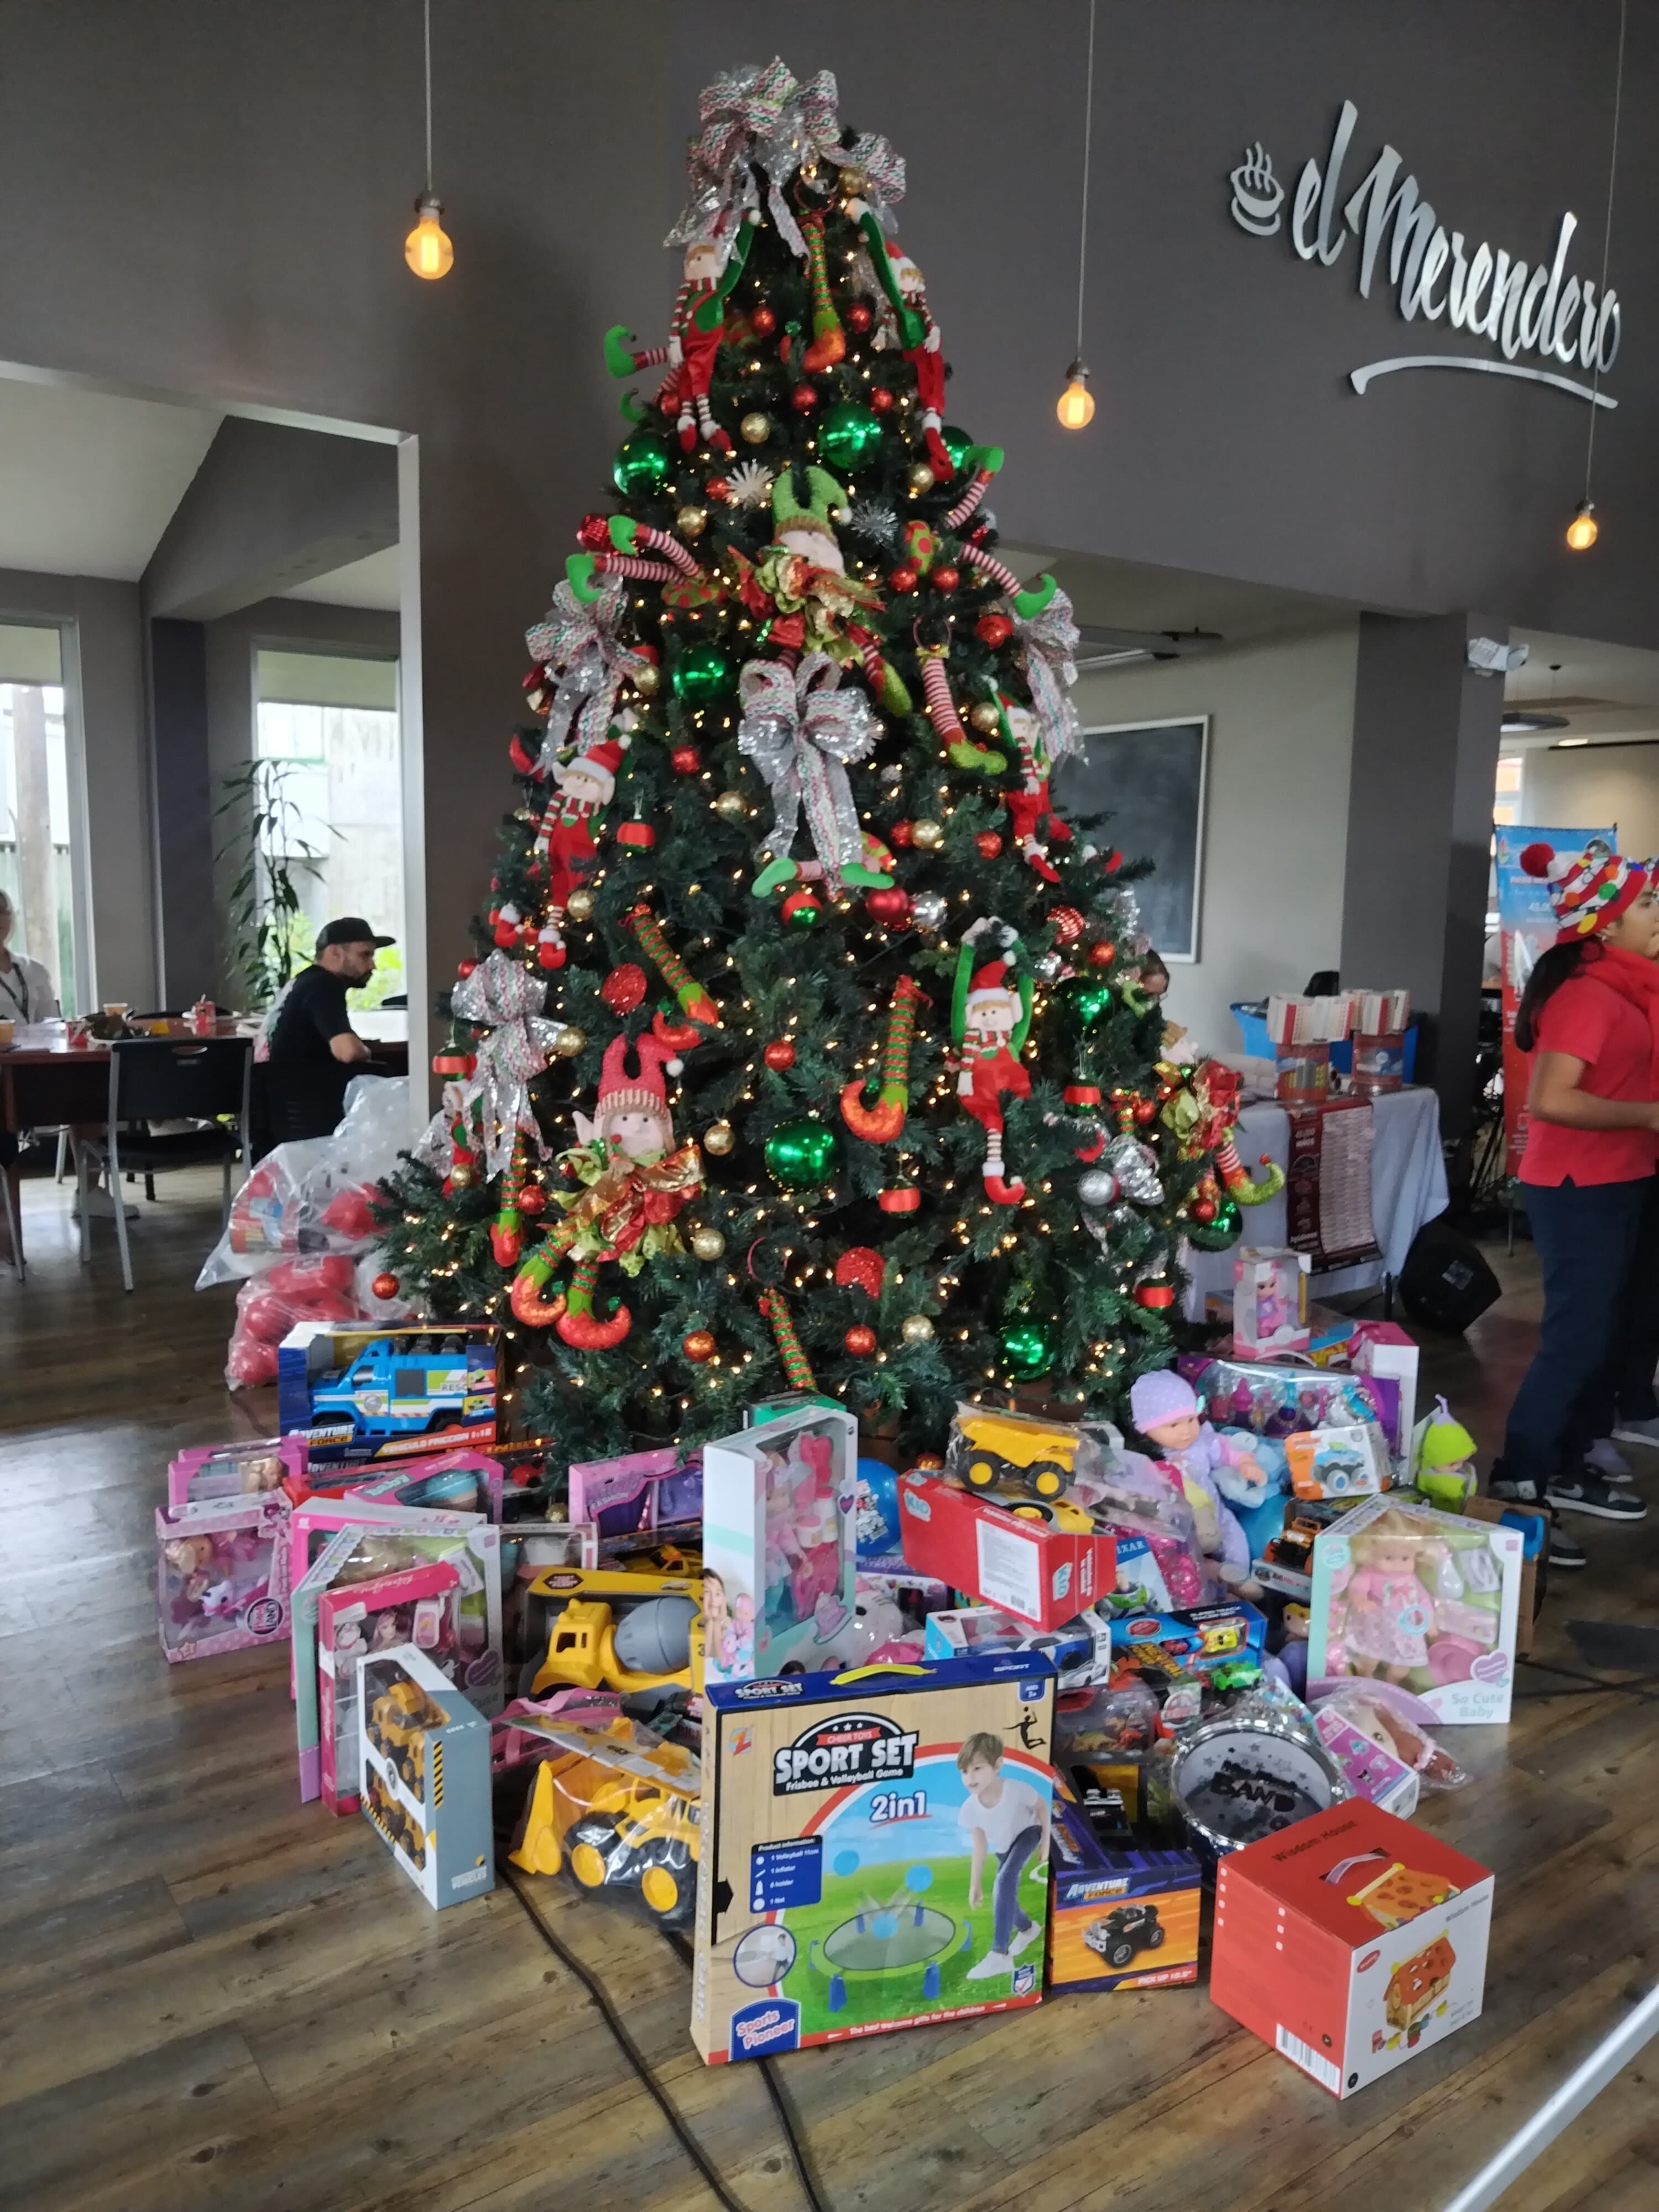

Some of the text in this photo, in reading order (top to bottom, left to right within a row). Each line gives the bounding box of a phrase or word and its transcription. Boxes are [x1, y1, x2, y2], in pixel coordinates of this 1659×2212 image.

[1344, 144, 1620, 374] Merendero
[906, 1493, 930, 1515] KID
[1117, 1540, 1146, 1555] IXAR
[993, 1664, 1030, 1673] SPORT
[734, 1687, 777, 1699] SPORT
[780, 1683, 803, 1693] SET
[775, 1733, 918, 1785] SPORT SET
[785, 1768, 904, 1792] Frisbee & Volleyball Game
[870, 1790, 927, 1823] 2in1
[1272, 1820, 1358, 1862] Wisdom House
[737, 2011, 780, 2036] Sports
[743, 2019, 795, 2049] Pioneer
